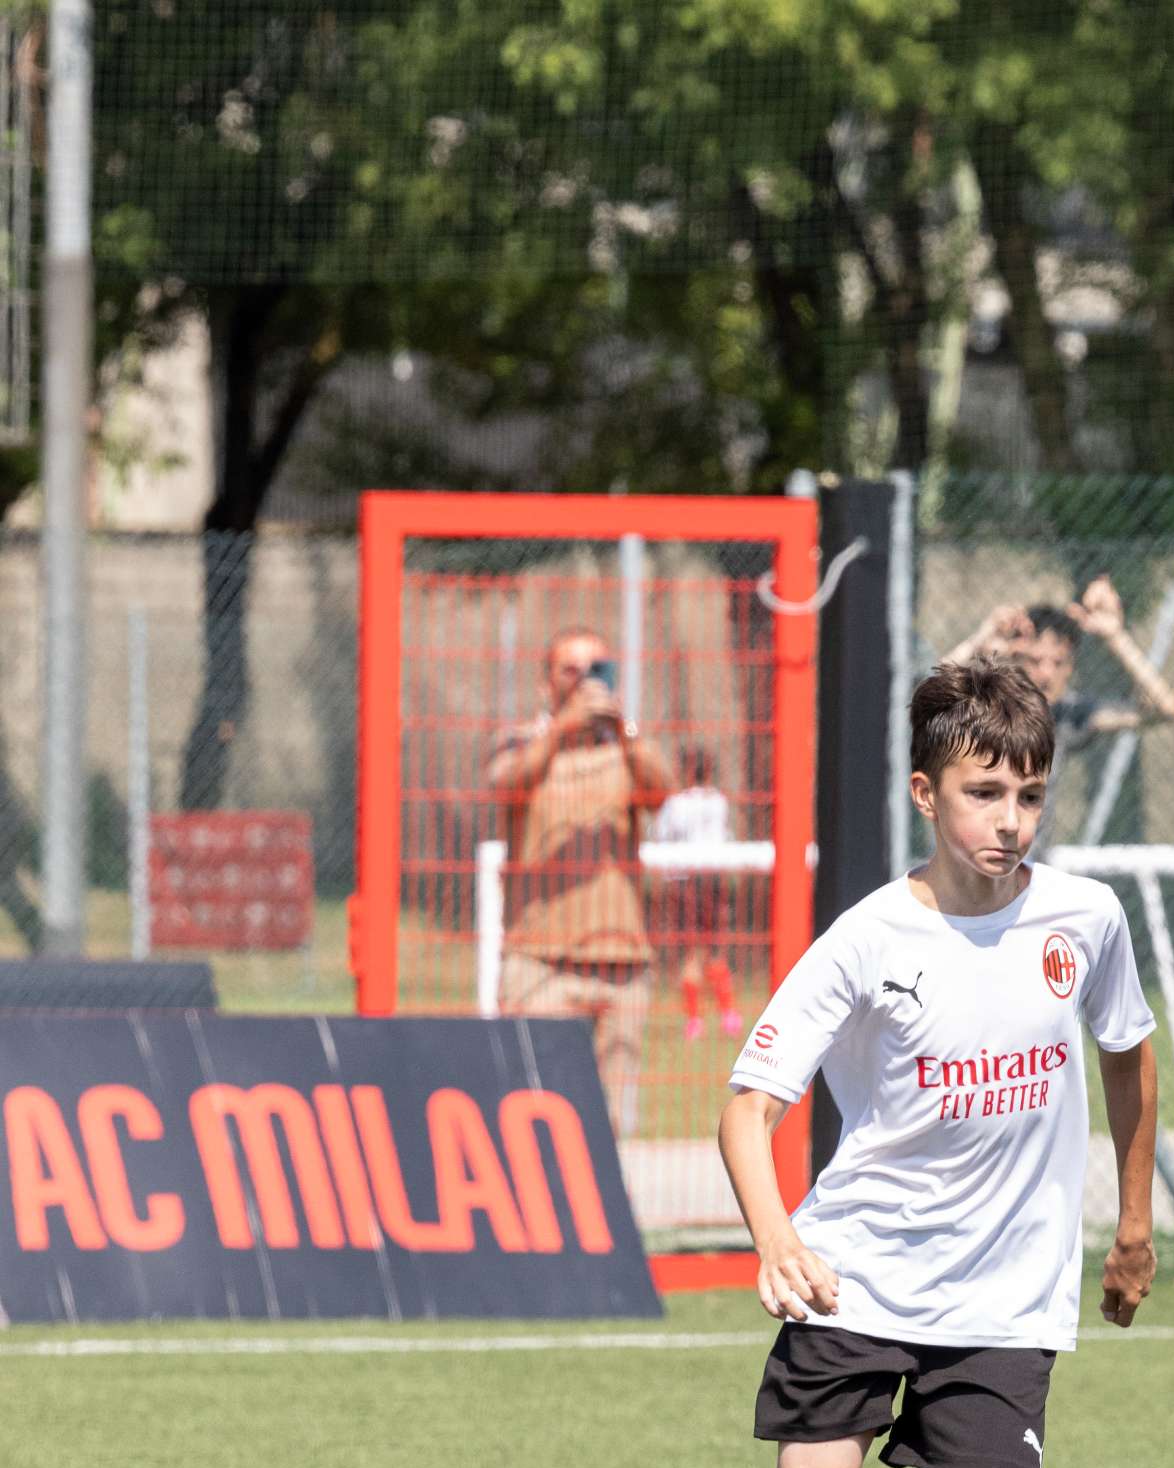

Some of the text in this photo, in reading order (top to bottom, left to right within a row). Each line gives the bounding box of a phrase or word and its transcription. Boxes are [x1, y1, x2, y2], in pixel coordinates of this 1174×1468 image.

[913, 1042, 1068, 1088] Emirates
[939, 1080, 1049, 1120] FLY BETTER
[3, 1083, 615, 1254] AC MILAN
